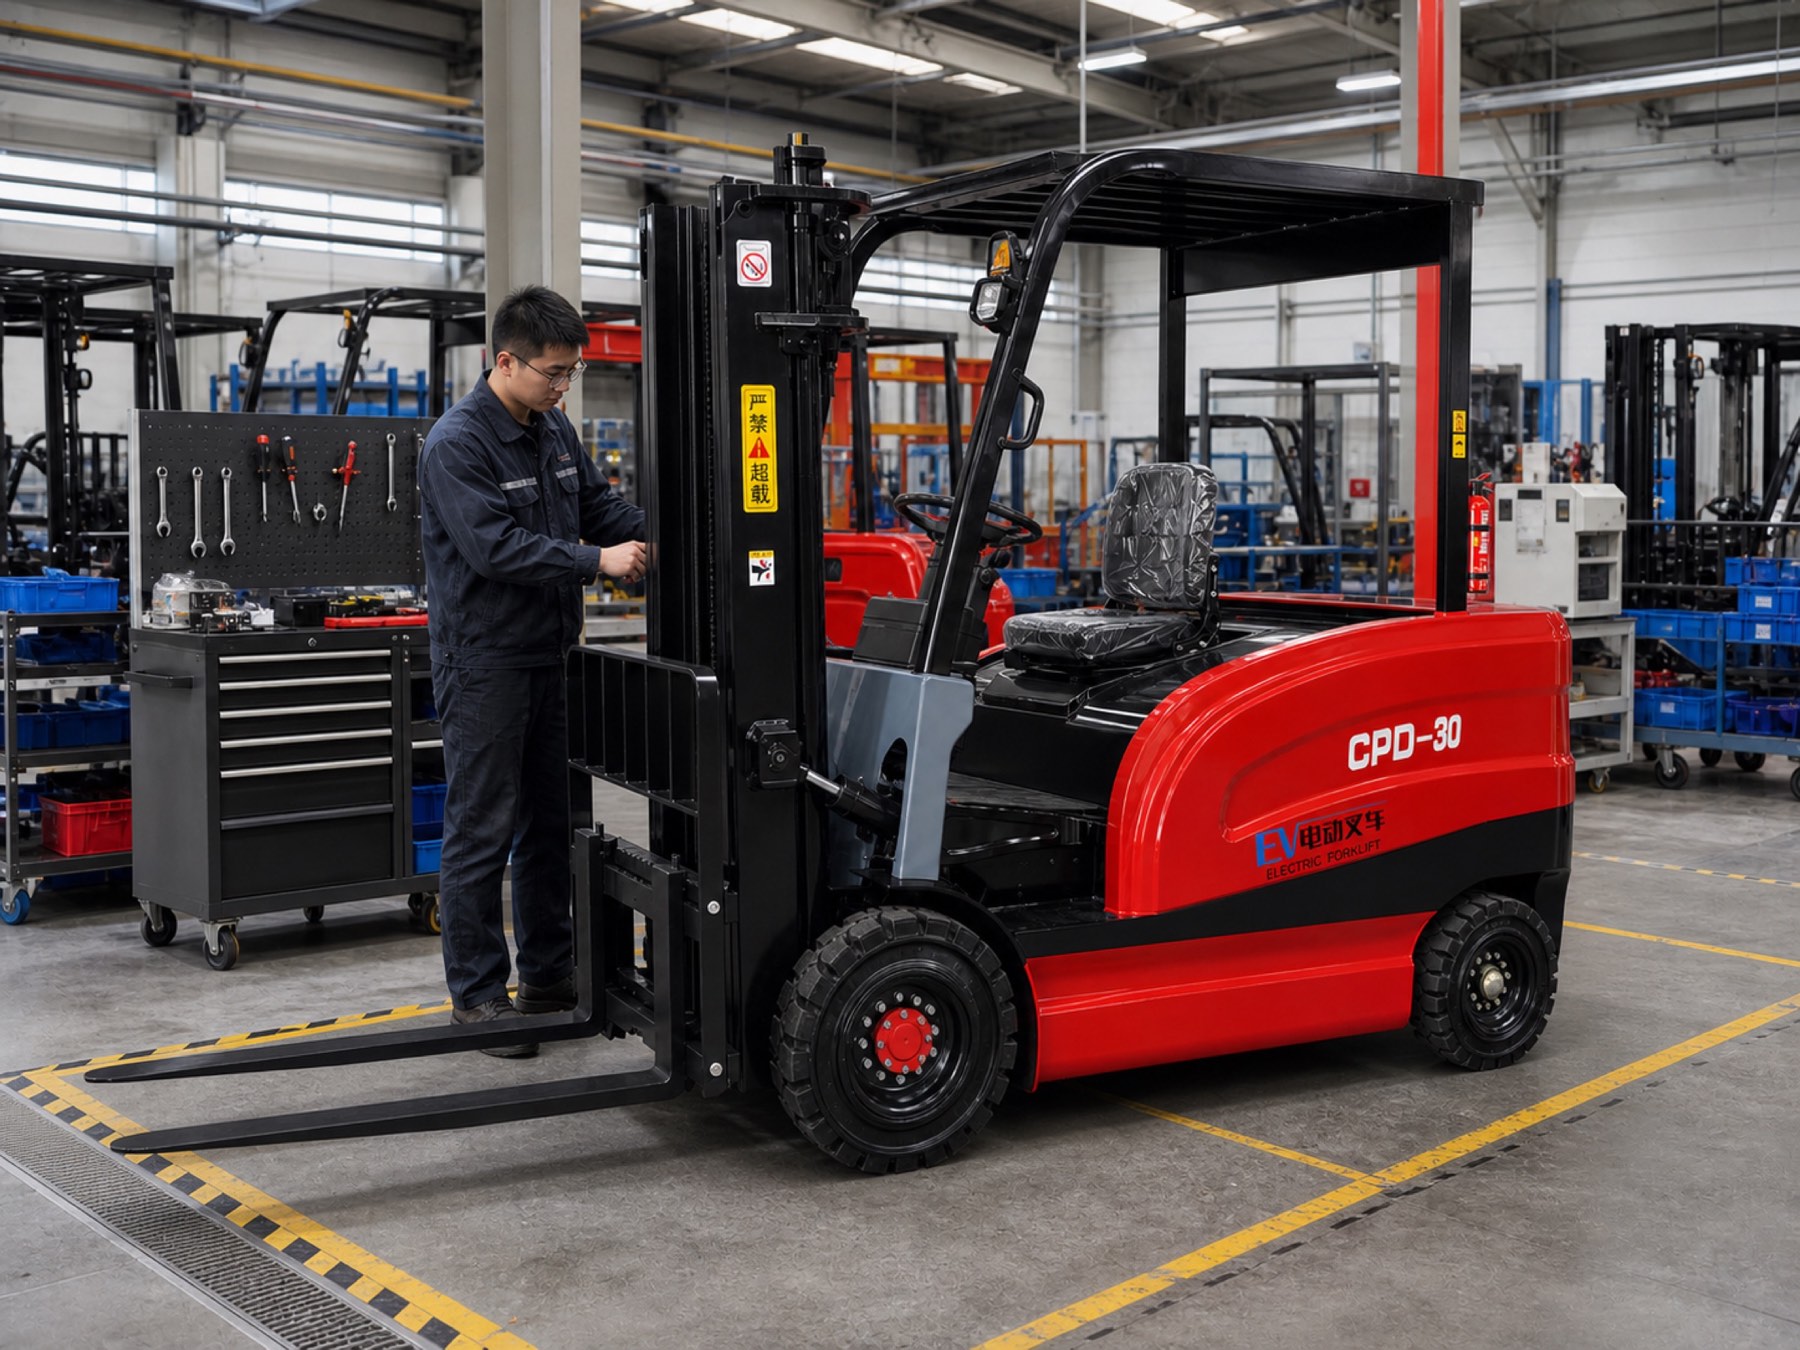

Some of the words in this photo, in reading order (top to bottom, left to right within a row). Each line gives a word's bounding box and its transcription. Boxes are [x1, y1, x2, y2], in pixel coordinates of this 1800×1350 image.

[1348, 714, 1462, 771] CPD-30
[1266, 855, 1322, 880] ELECTRIC
[1327, 838, 1381, 864] FORKLIFT
